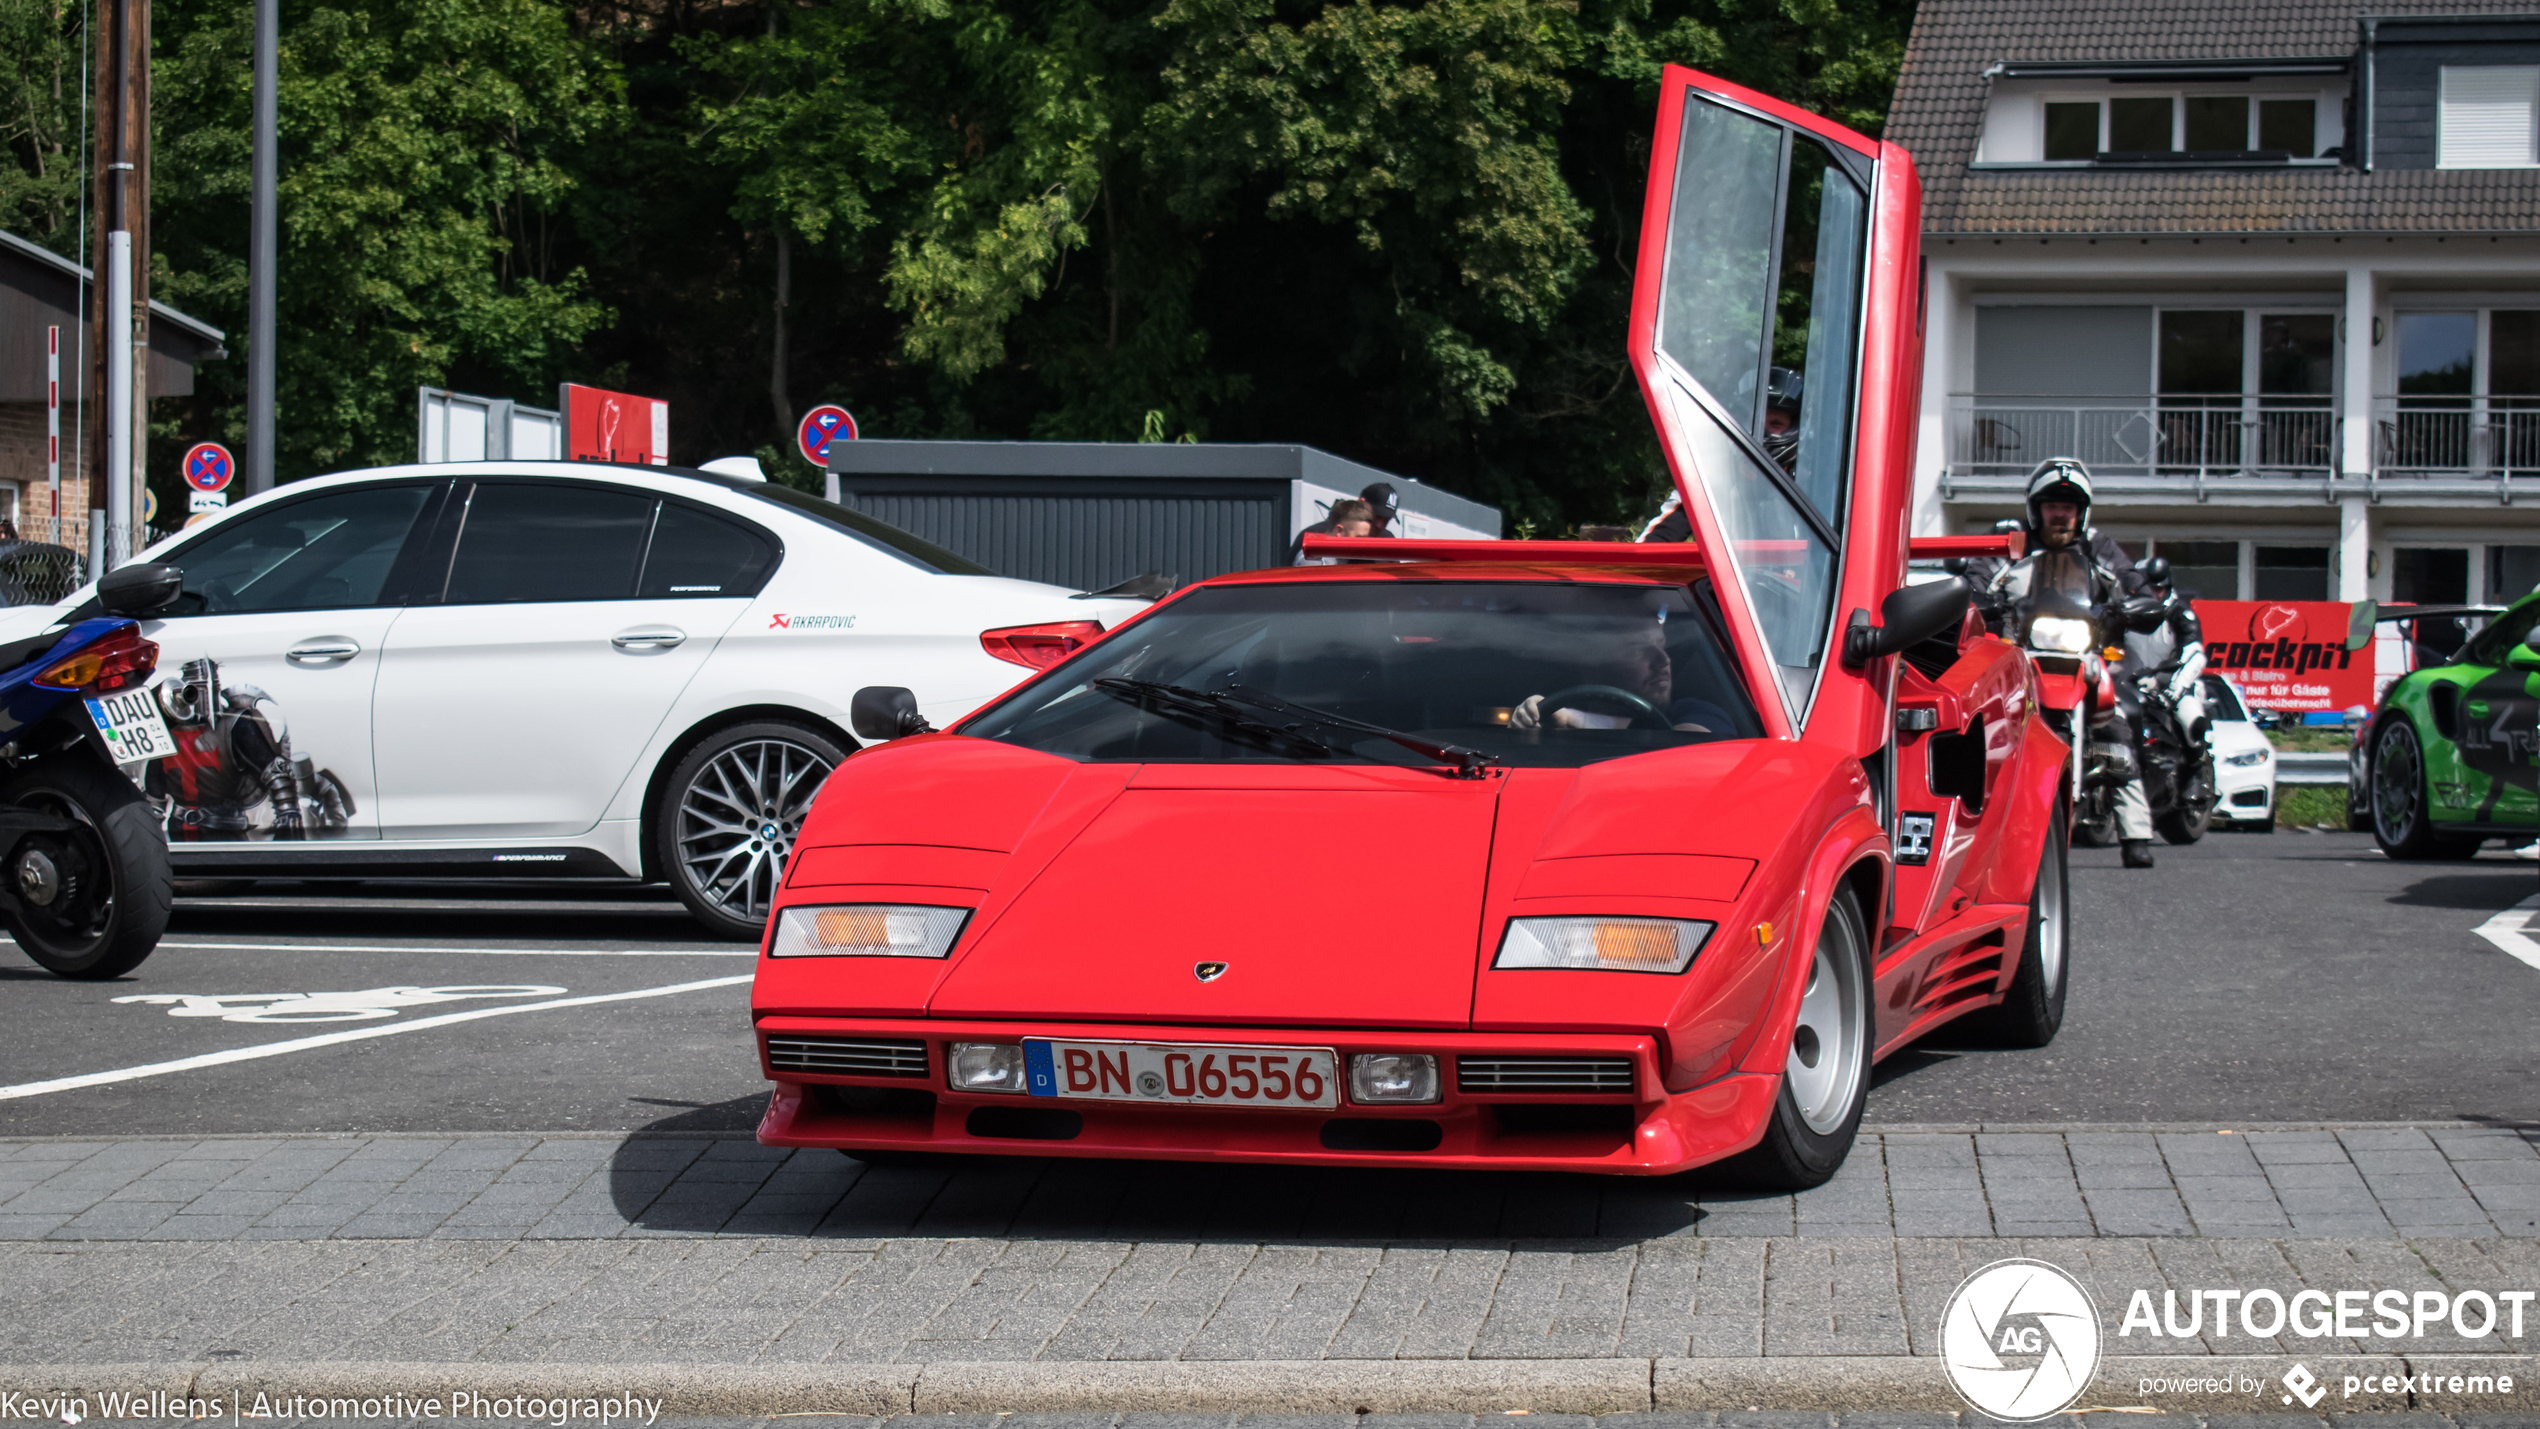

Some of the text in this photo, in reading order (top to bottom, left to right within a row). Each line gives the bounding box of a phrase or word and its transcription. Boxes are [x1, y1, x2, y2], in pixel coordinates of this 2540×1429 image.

[2205, 637, 2351, 675] cockpit
[2246, 686, 2267, 696] nur
[2270, 684, 2289, 696] für
[104, 692, 155, 726] DAU
[119, 727, 154, 757] H8
[1037, 1074, 1047, 1087] D
[1064, 1048, 1324, 1101] BN 06556
